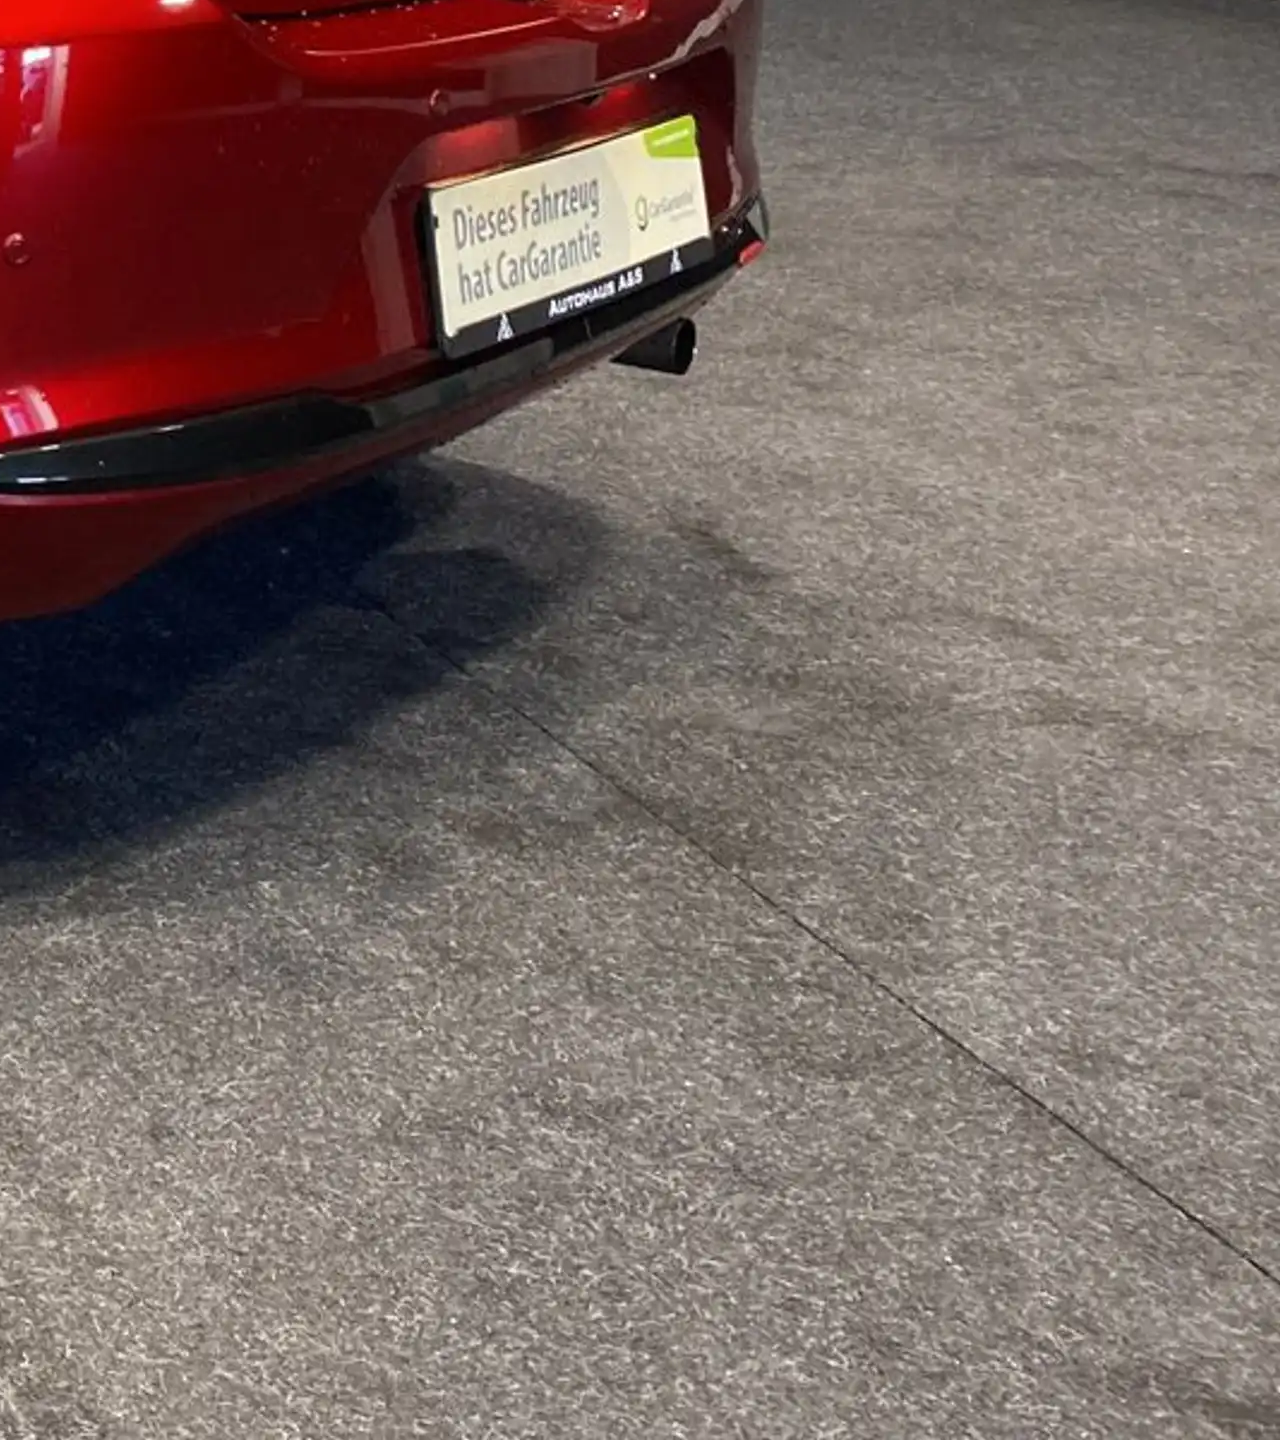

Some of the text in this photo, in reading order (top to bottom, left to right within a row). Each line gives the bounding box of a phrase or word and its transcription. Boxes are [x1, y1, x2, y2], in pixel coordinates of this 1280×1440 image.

[452, 204, 516, 250] Dieses
[521, 177, 600, 230] Fahrzeug
[458, 225, 602, 305] hat CarGarantie
[548, 279, 617, 317] AUTOHAUS
